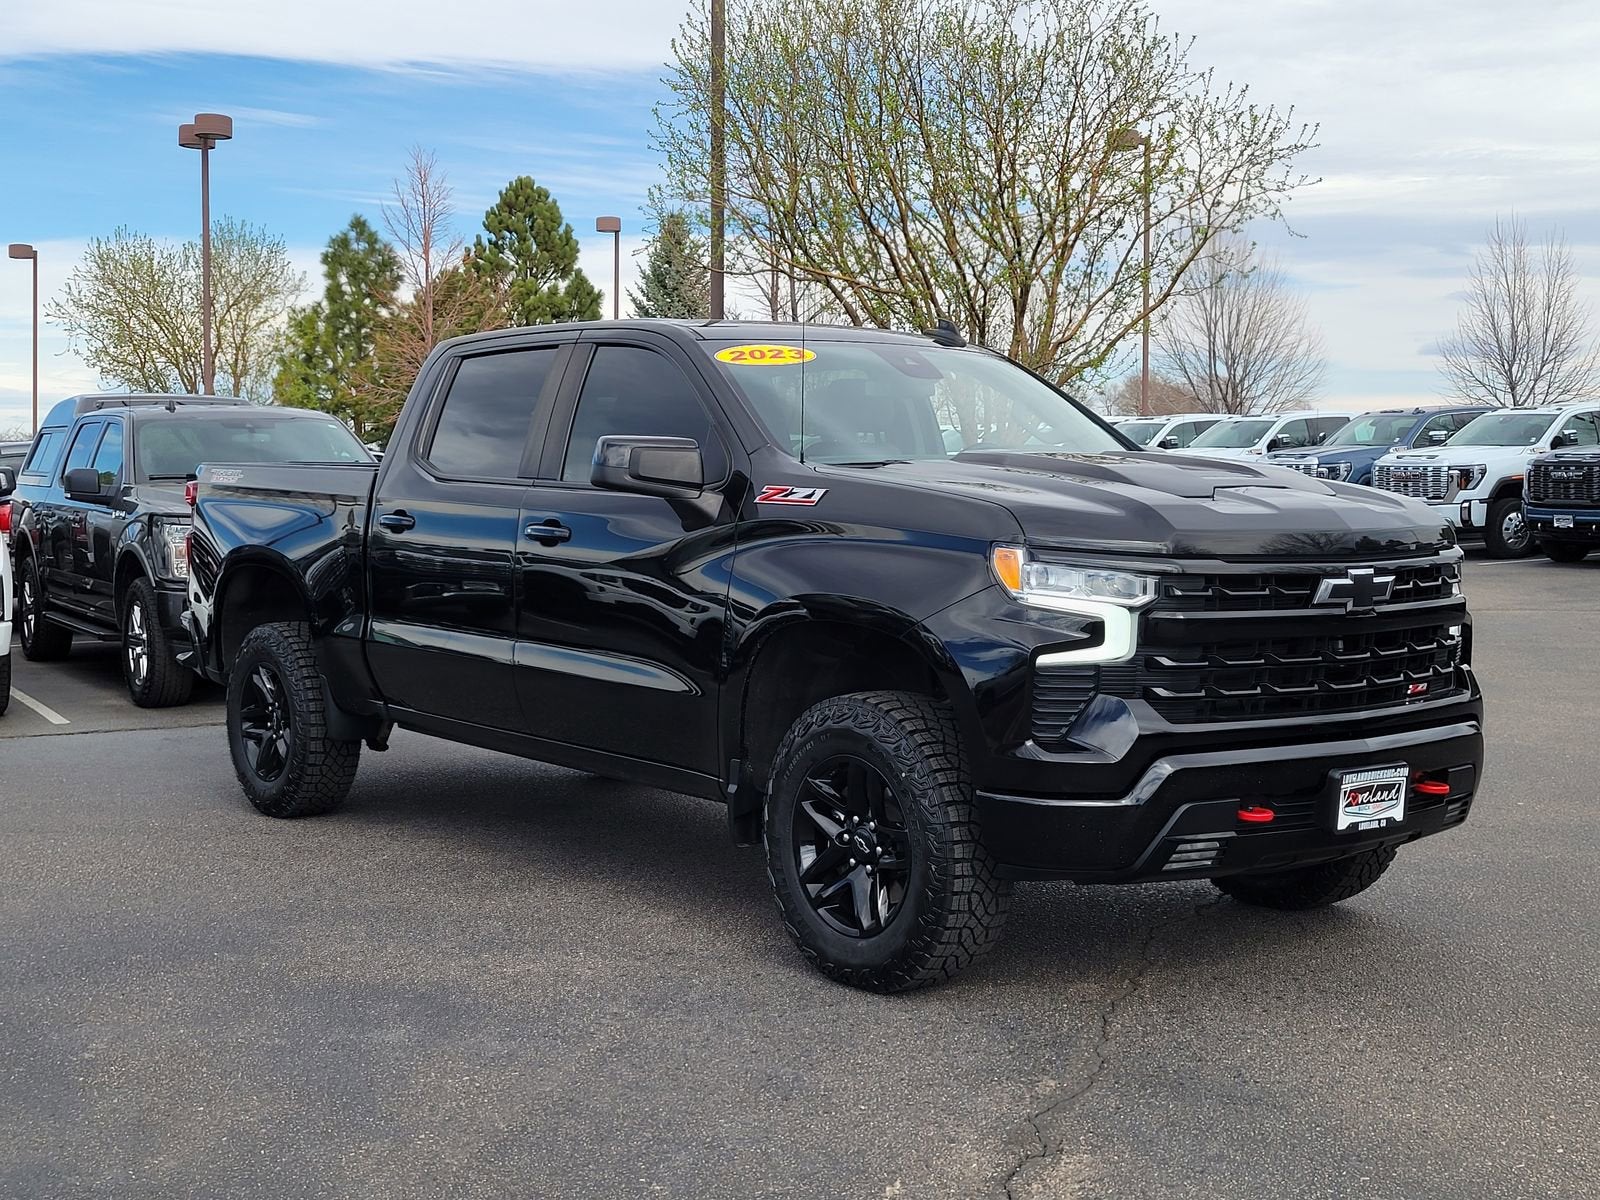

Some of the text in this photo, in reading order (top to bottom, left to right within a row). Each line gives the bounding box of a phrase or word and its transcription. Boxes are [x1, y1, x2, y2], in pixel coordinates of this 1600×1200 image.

[729, 349, 805, 361] 2023
[1550, 471, 1584, 480] GMC
[753, 485, 829, 506] Z71
